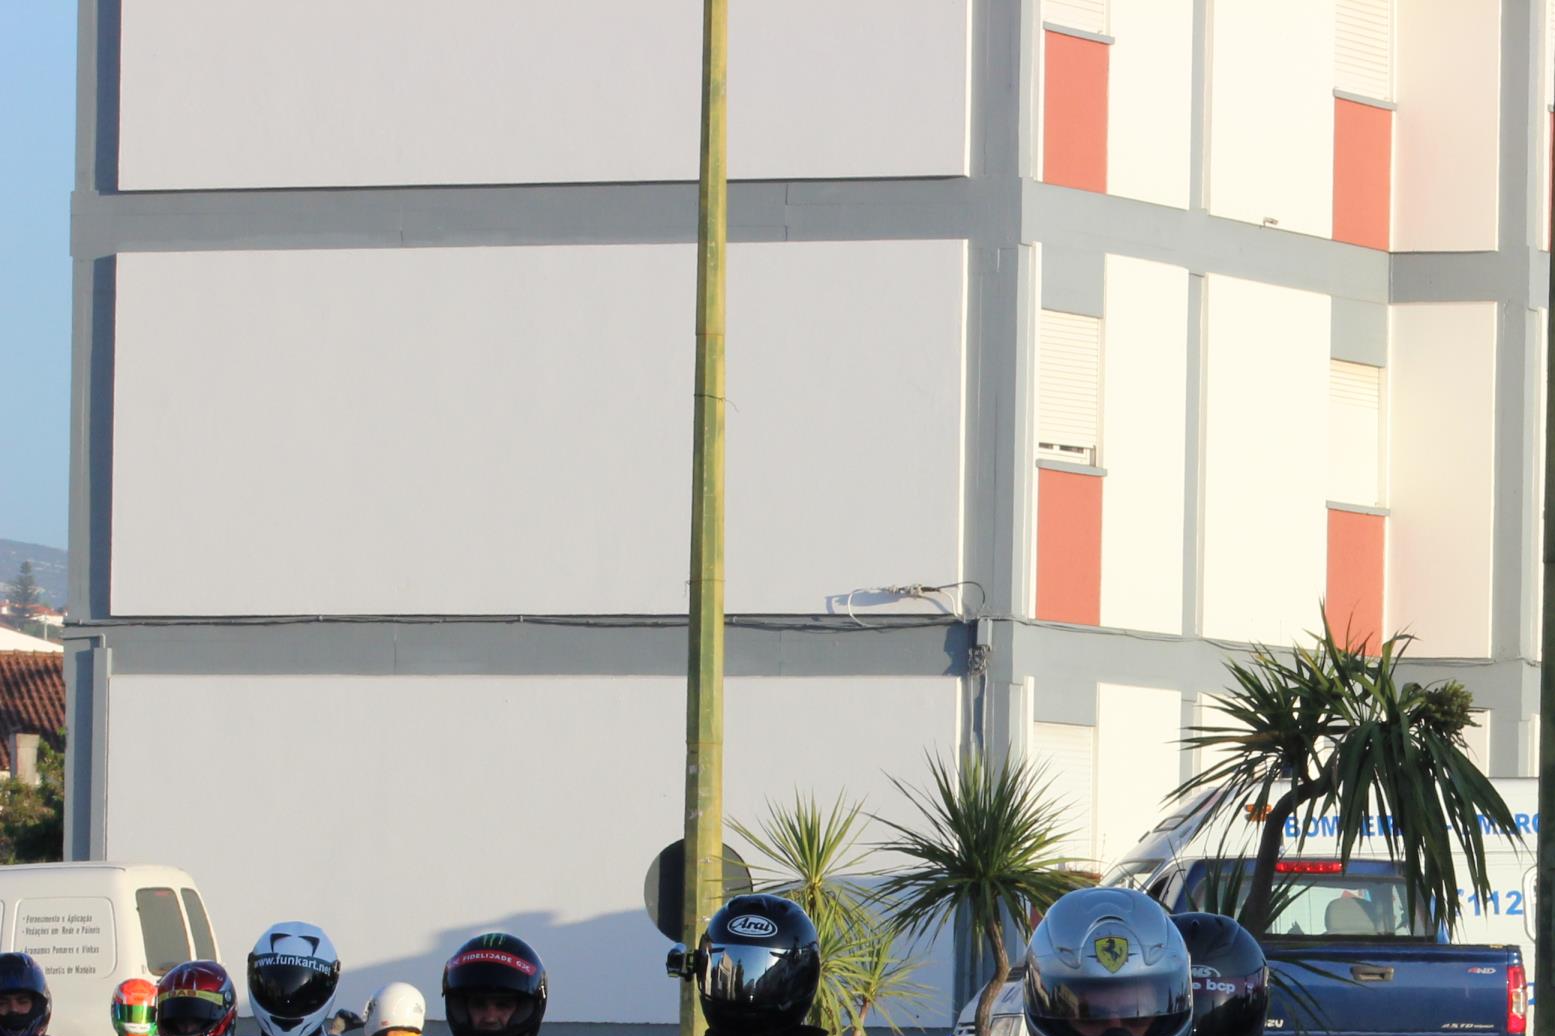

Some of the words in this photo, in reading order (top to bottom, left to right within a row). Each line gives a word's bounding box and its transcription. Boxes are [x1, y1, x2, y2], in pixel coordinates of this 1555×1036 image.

[1468, 890, 1524, 916] 112
[734, 917, 771, 933] Arai
[1206, 979, 1236, 994] bcp
